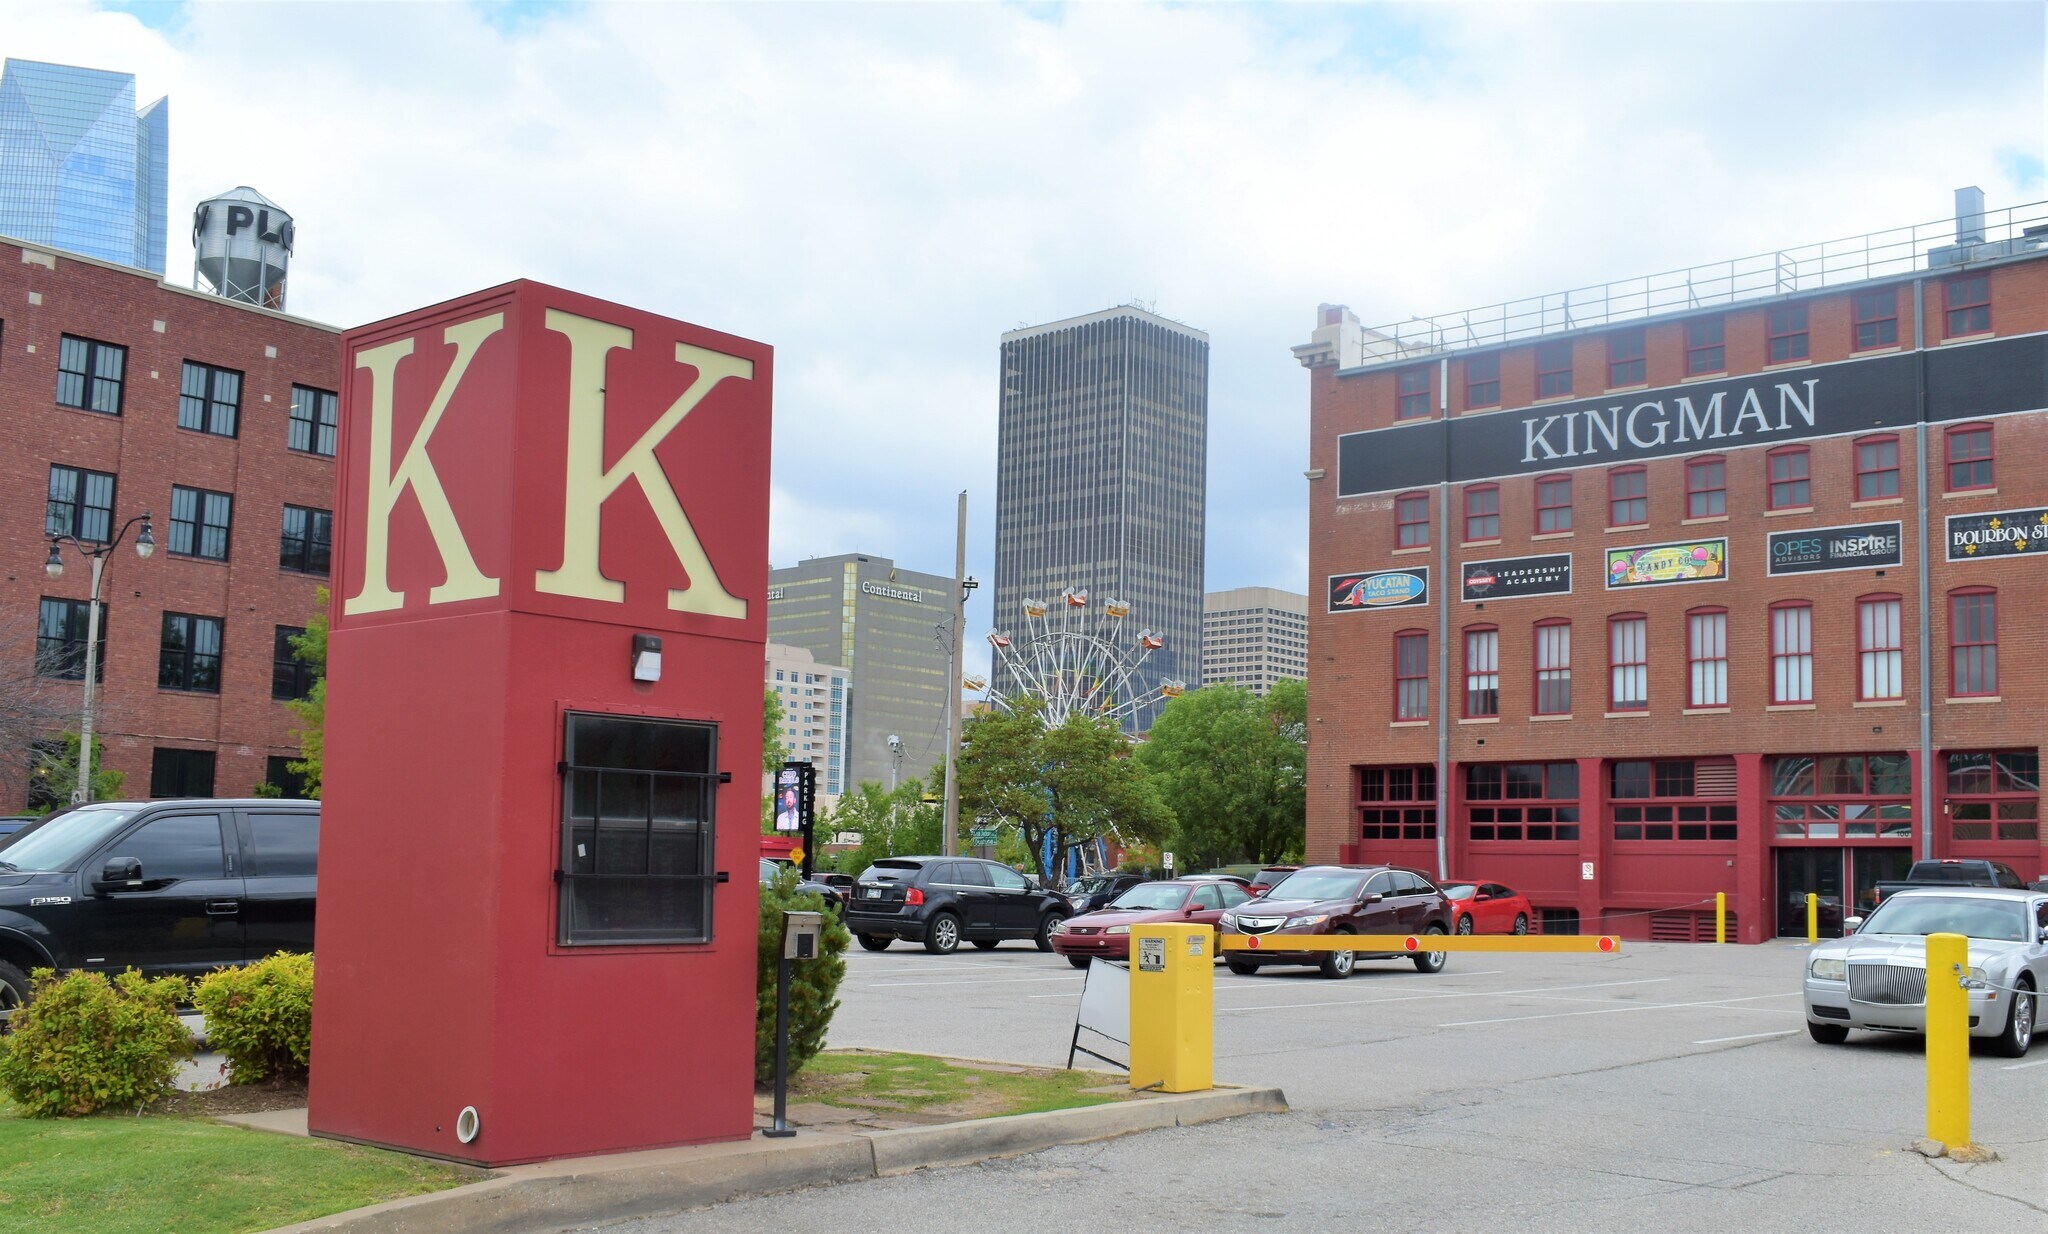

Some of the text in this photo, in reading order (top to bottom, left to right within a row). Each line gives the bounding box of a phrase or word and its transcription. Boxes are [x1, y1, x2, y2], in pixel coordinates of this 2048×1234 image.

[1520, 378, 1820, 463] KINGMAN
[344, 311, 504, 616] K
[535, 306, 755, 620] K
[1829, 535, 1897, 553] INSPIRE
[1953, 526, 2028, 546] BOURBON
[1773, 538, 1822, 556] OPES
[1829, 547, 1897, 559] FINANCIAL GROUP
[1640, 558, 1673, 572] CANDY
[1775, 553, 1821, 563] ADVISORS
[1497, 565, 1569, 578] LEADERSHIP
[1366, 575, 1411, 590] YUCATAN
[1506, 575, 1560, 586] ACADEMY
[862, 581, 922, 603] Continental
[1386, 587, 1410, 595] STAND
